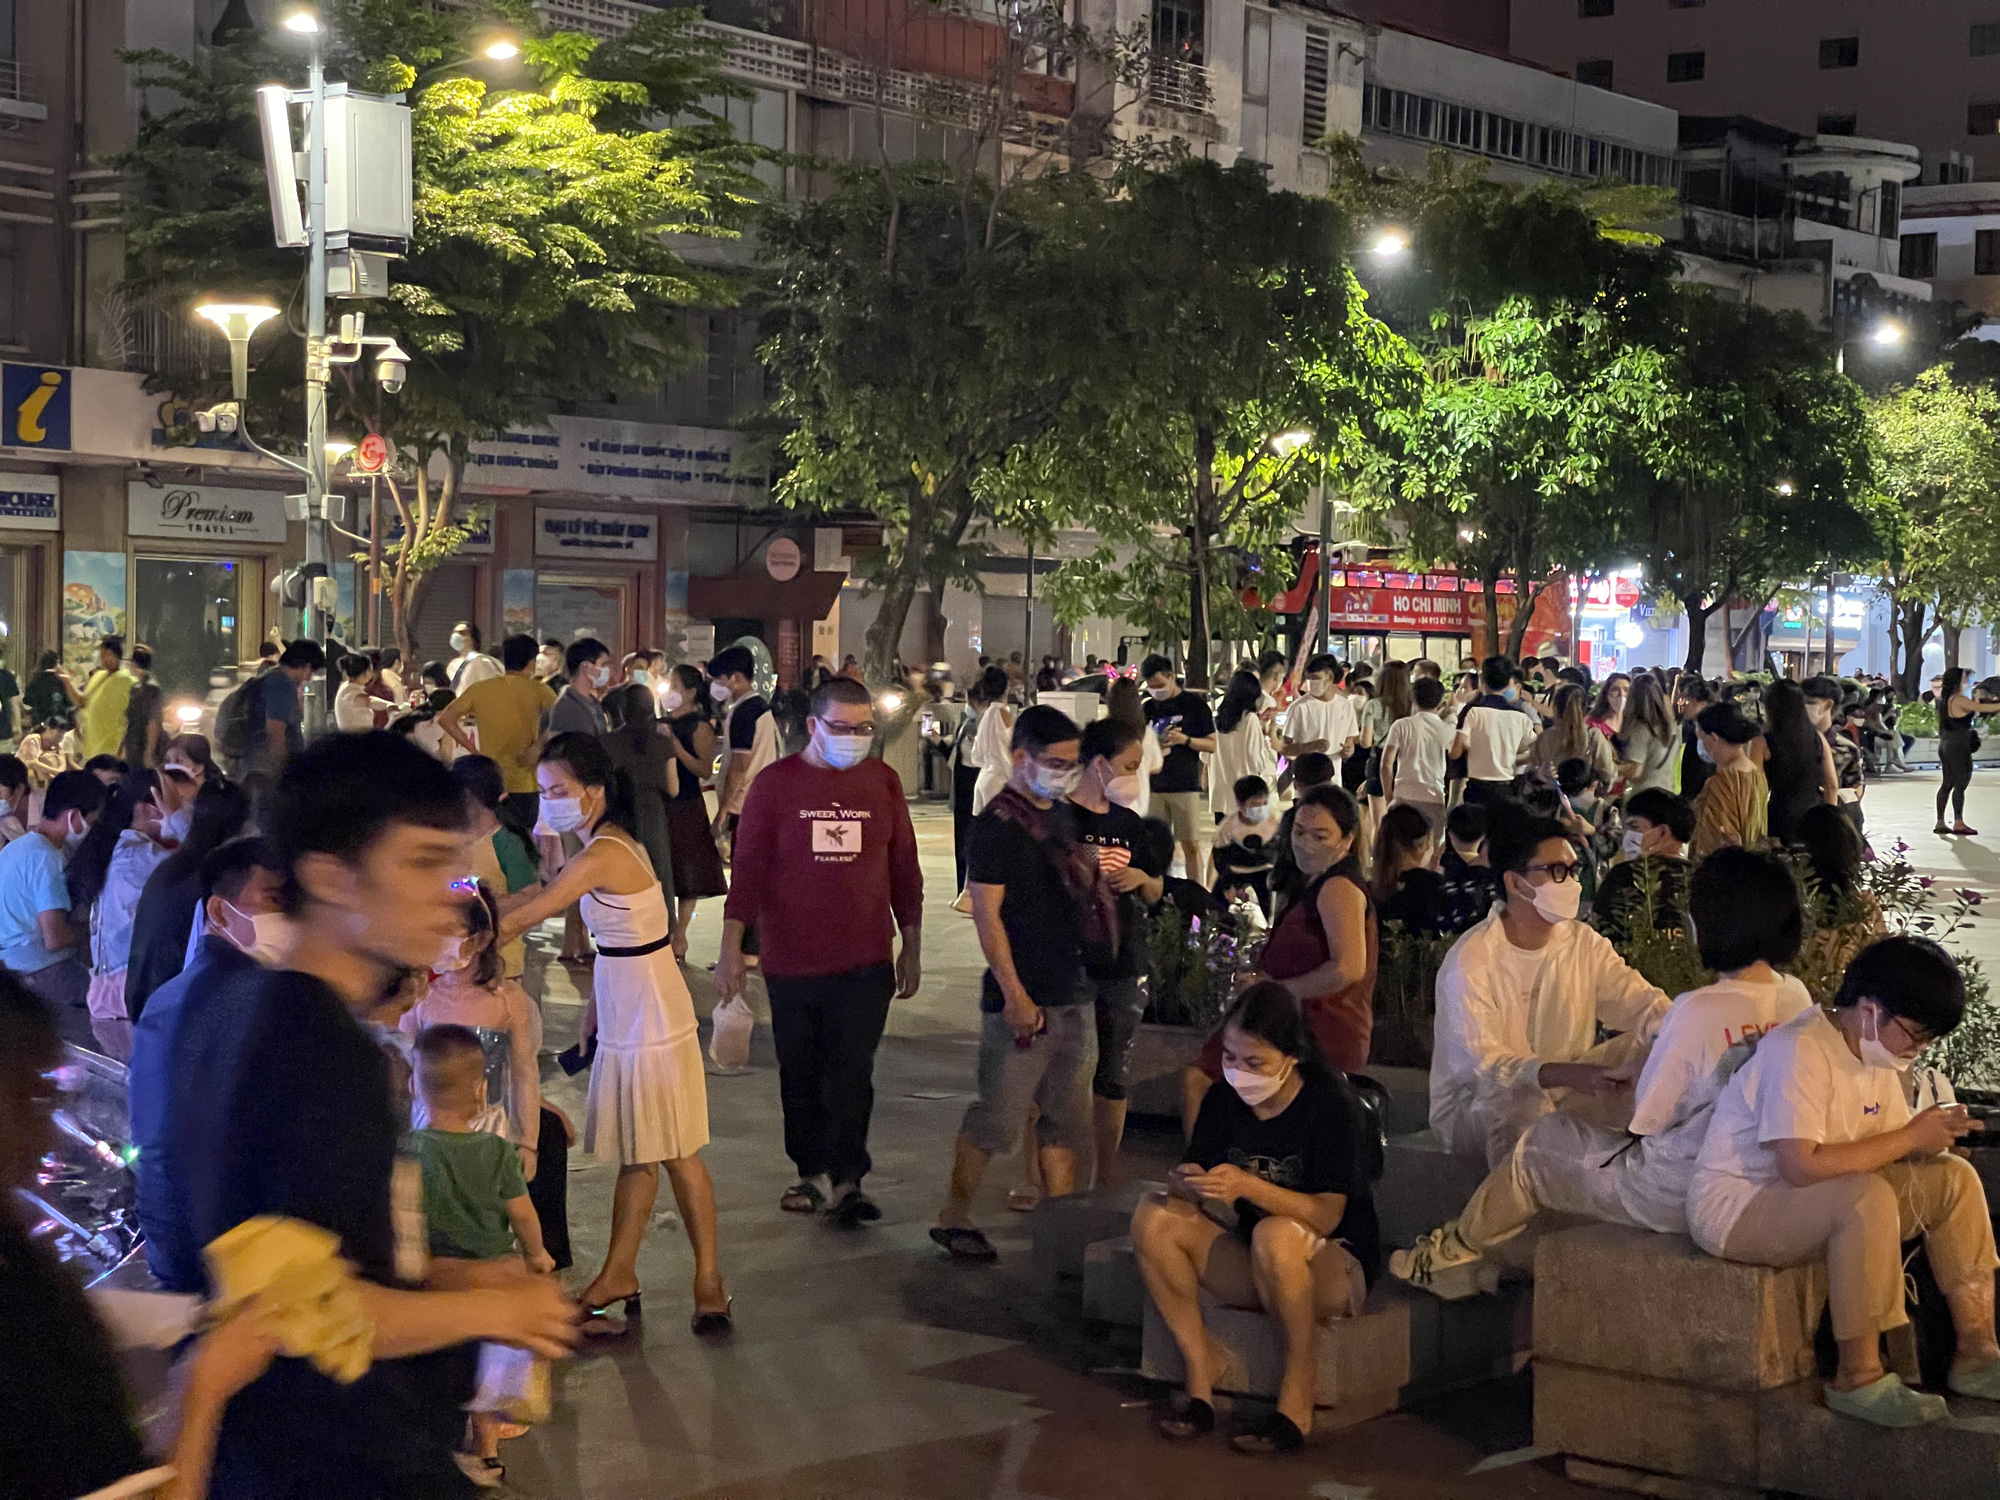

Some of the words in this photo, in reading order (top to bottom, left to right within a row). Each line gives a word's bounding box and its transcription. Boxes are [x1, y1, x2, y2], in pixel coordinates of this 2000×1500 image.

[187, 524, 235, 535] TRAVEL
[1393, 595, 1410, 612] HO
[1411, 596, 1431, 613] CHI
[1432, 597, 1462, 614] MINH
[840, 809, 871, 819] WORK
[1085, 834, 1130, 848] OMMY
